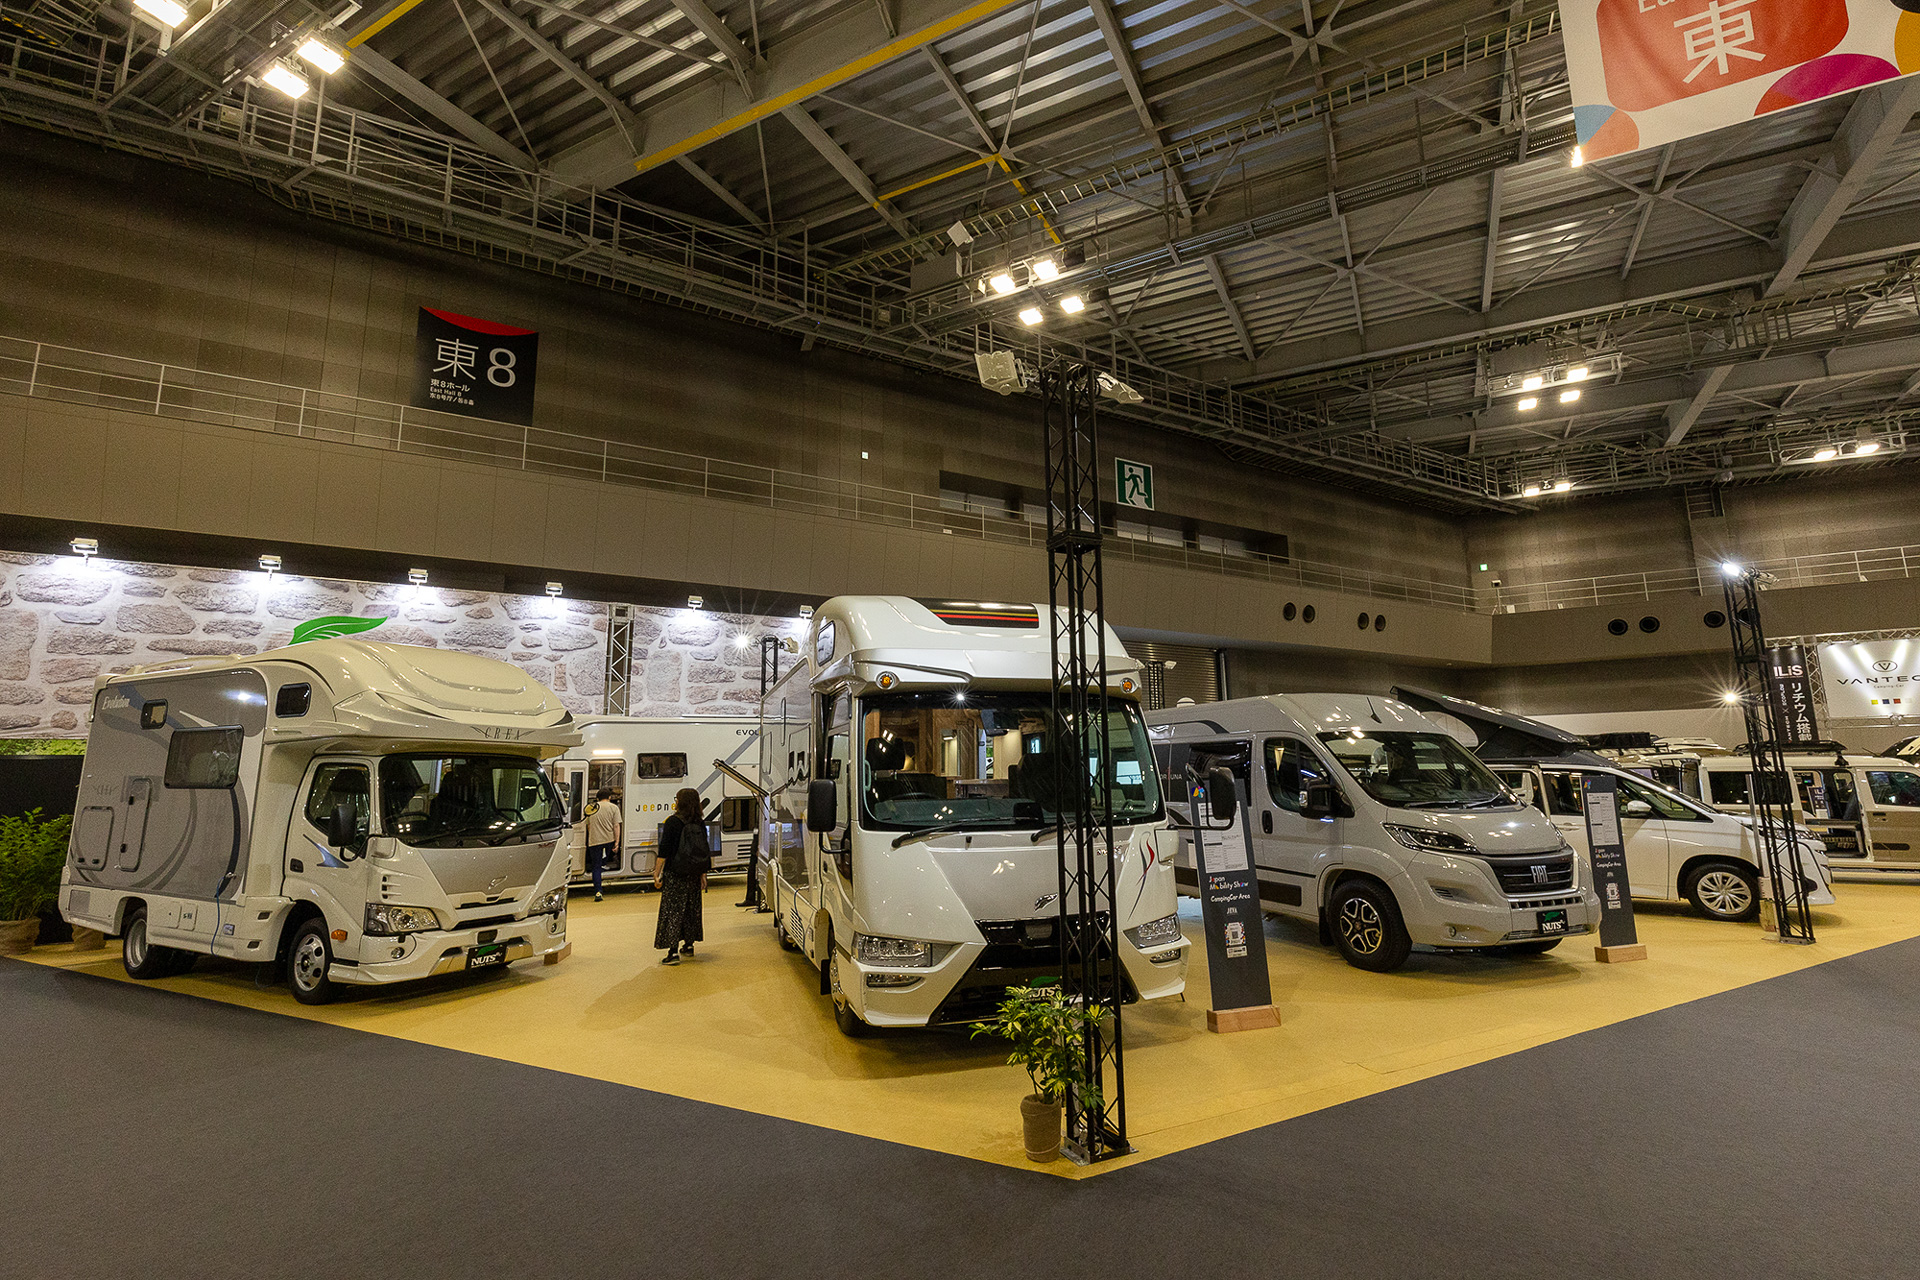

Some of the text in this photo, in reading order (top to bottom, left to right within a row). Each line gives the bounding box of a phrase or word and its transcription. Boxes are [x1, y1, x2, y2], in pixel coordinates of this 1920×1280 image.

[1673, 0, 1766, 84] 東
[431, 379, 470, 391] 東8ホール
[1530, 865, 1548, 883] FIAT
[1542, 922, 1562, 931] NUTS
[471, 954, 497, 966] NUTS
